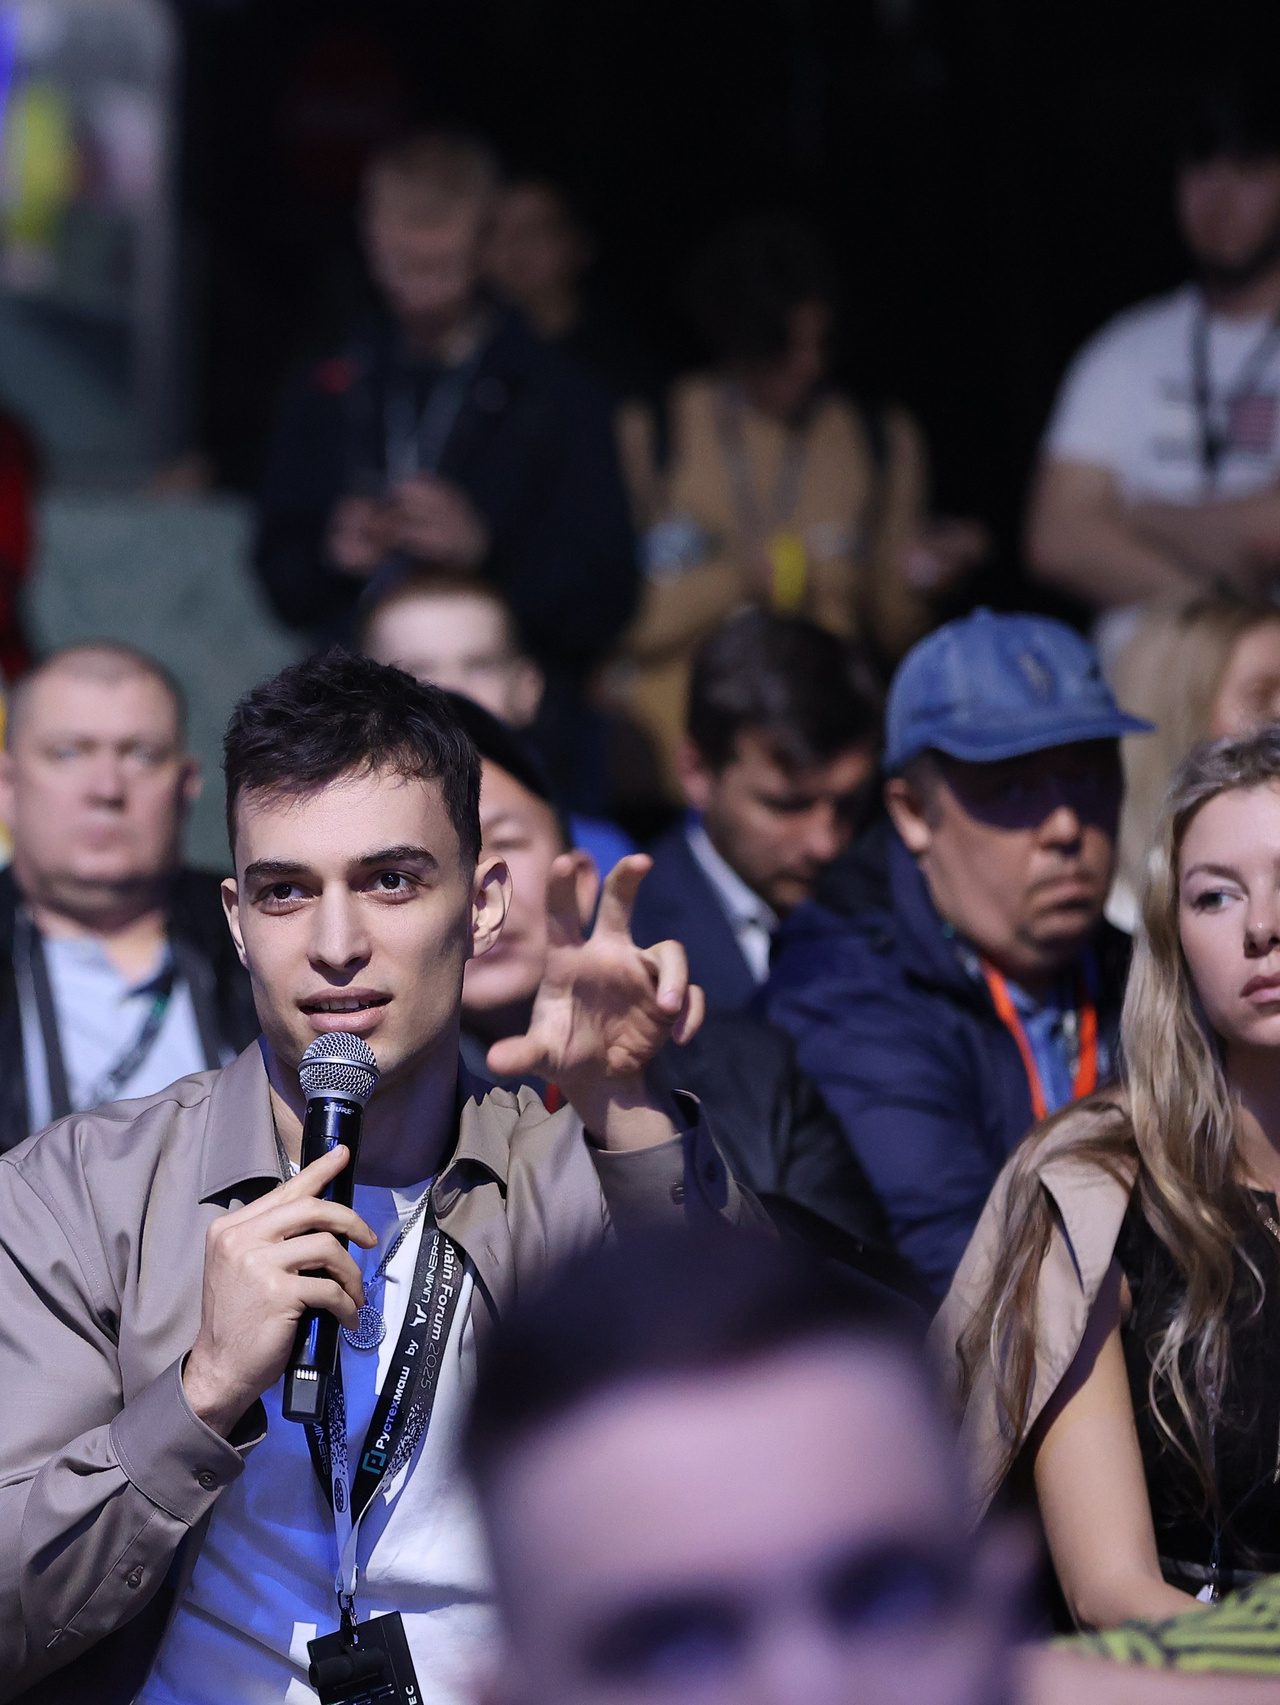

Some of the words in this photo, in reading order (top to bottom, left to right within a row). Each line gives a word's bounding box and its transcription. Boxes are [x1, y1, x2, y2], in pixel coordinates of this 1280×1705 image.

[432, 1283, 454, 1341] Forum
[375, 1366, 410, 1450] Рустехмаш
[404, 1339, 419, 1357] by
[421, 1342, 440, 1390] 2025
